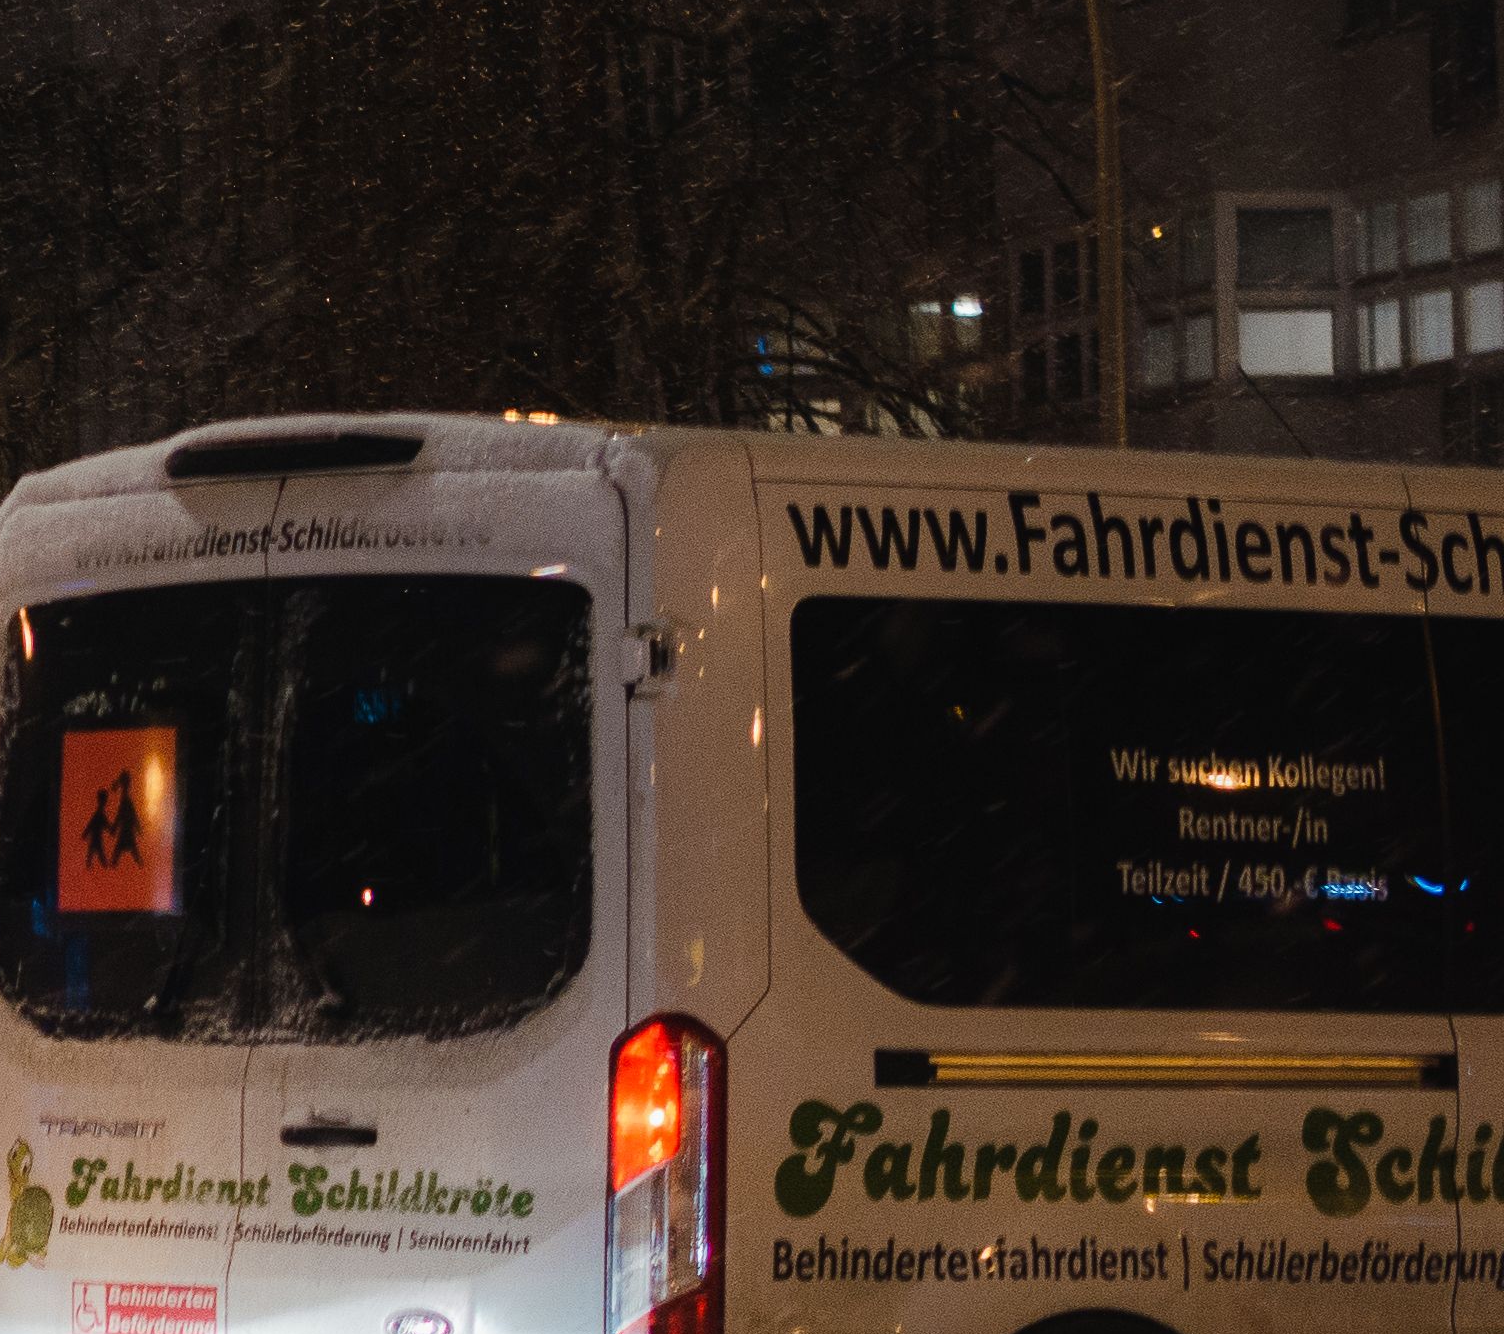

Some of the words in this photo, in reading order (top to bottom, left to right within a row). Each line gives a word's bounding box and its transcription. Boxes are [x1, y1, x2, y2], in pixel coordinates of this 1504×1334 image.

[1110, 748, 1160, 783] Wir
[1167, 752, 1261, 788] suchen
[1267, 753, 1387, 798] Kollegen!
[1178, 806, 1330, 850] Rentner-/in
[1116, 861, 1211, 897] Teilzeit
[774, 1099, 1263, 1218] Fahrdienst
[65, 1156, 272, 1209] Fahrdienst
[289, 1163, 535, 1219] Schildkröte
[59, 1216, 219, 1241] Behindertenfahrdienst
[234, 1222, 391, 1253] Schülerbeförderung
[409, 1228, 530, 1255] Seniorenfahrt
[772, 1234, 1168, 1282] Behindertenfahrdienst
[108, 1284, 216, 1309] Behinderten
